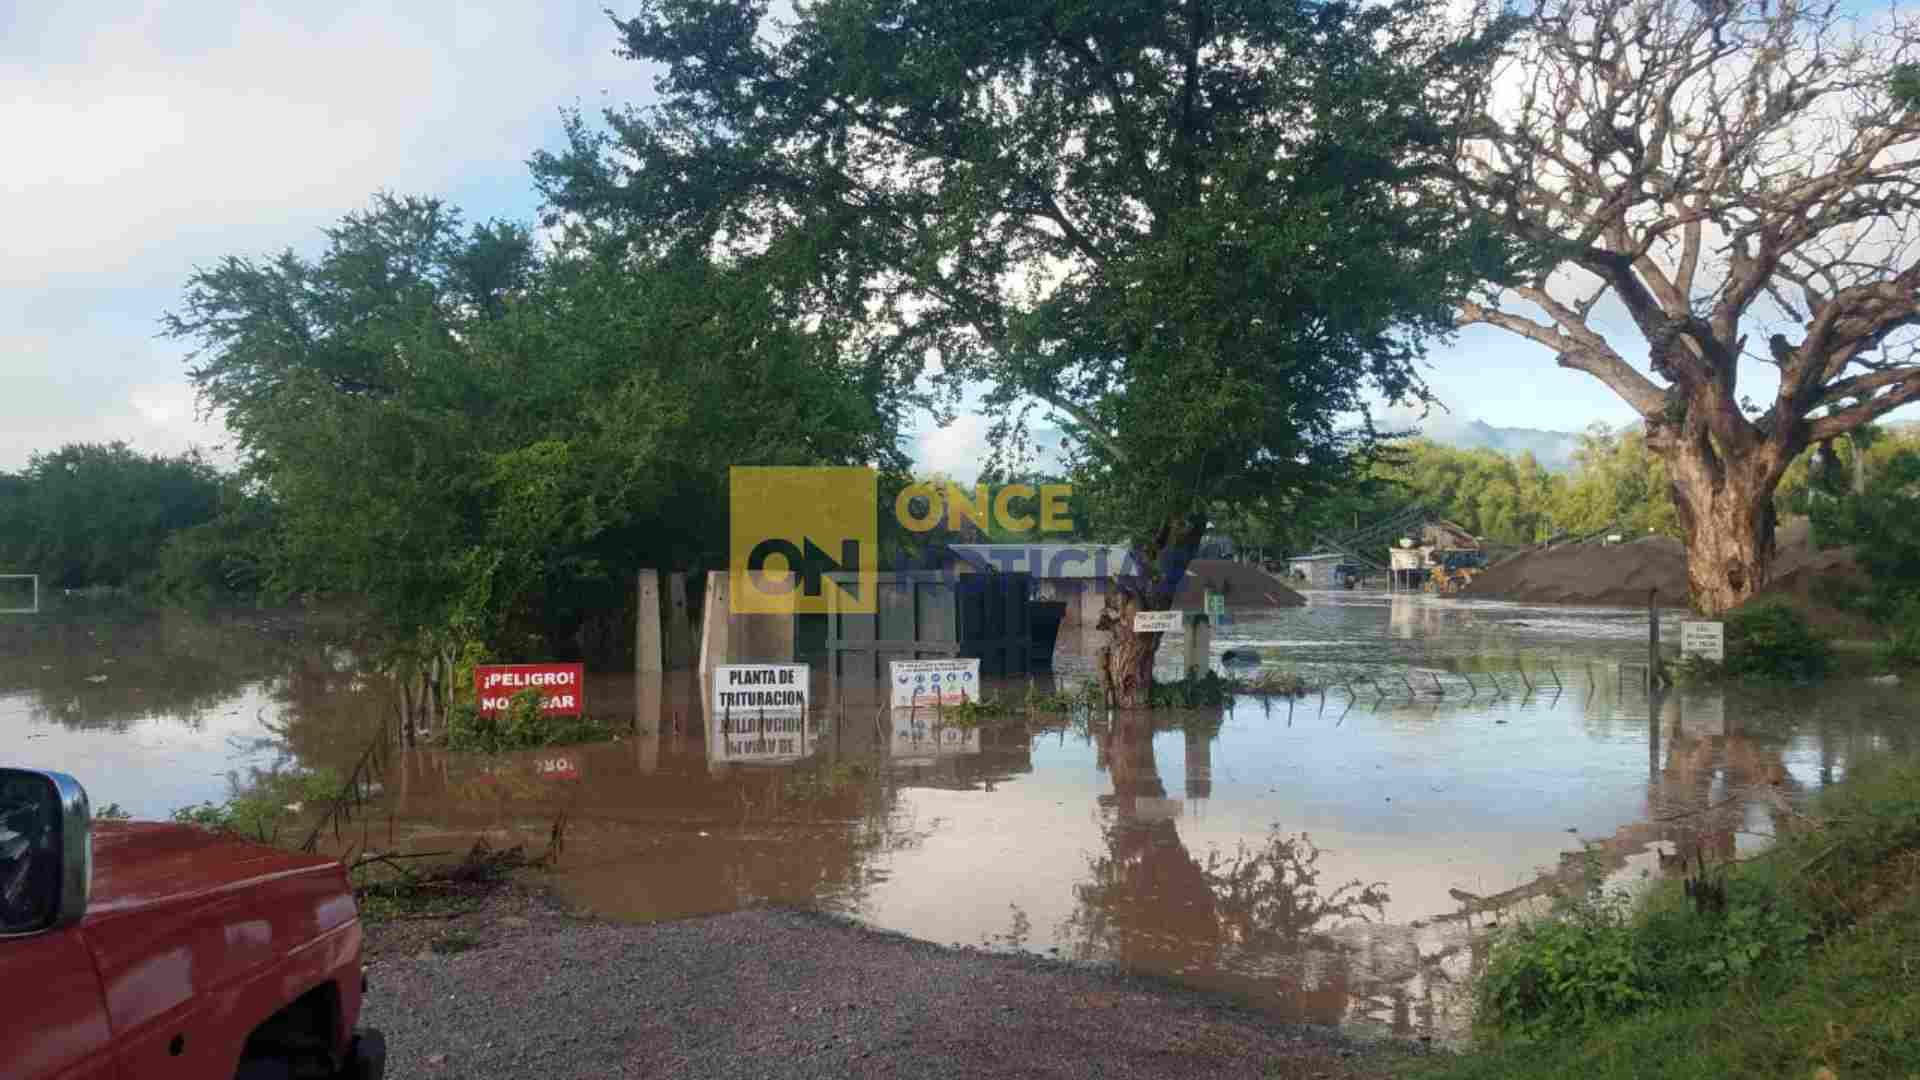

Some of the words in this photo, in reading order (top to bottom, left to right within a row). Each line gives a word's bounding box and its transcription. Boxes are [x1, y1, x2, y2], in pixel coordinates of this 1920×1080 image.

[484, 672, 575, 688] ¡PELIGRO!
[730, 670, 776, 685] PLANTA
[779, 670, 794, 684] DE
[482, 697, 509, 710] NO
[720, 690, 804, 706] TRITURACION
